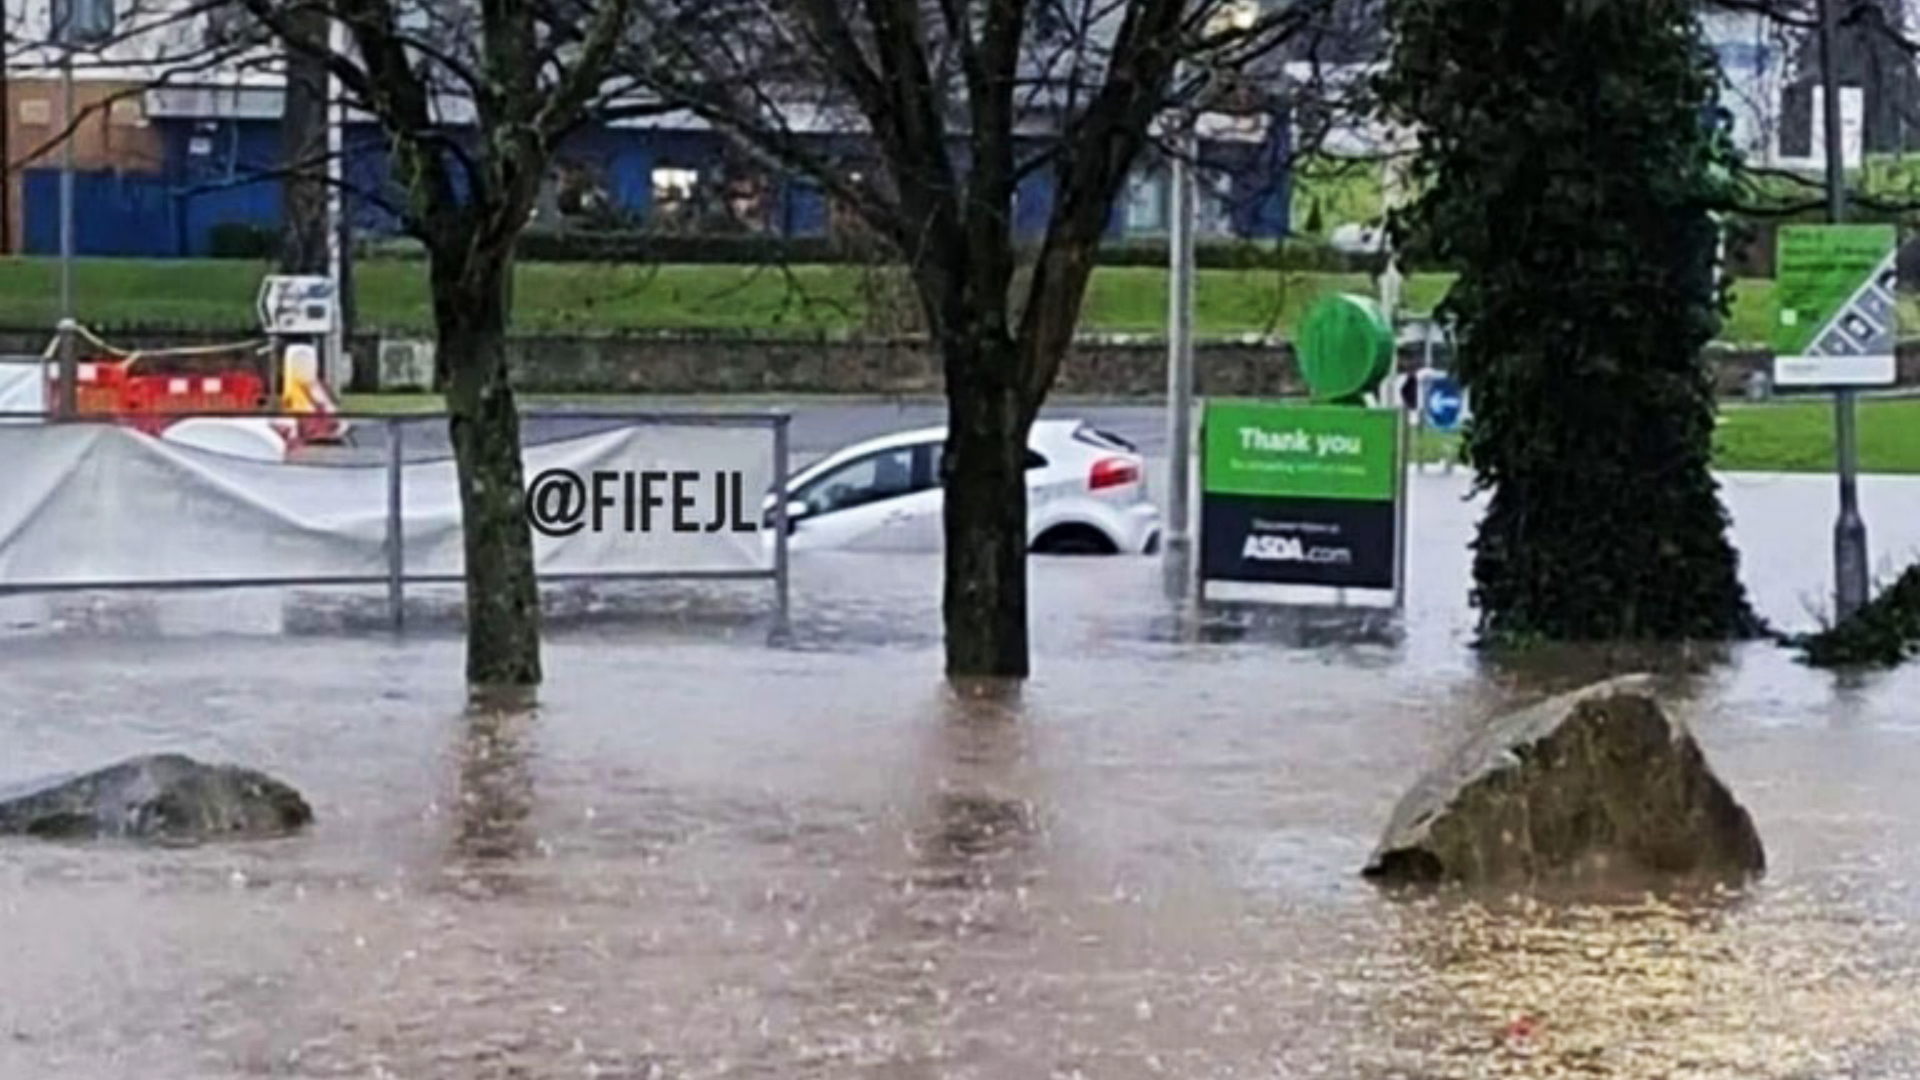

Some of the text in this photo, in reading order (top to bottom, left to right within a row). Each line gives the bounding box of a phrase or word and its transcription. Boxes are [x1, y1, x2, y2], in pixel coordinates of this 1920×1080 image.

[1239, 427, 1361, 456] Thank you
[1242, 534, 1352, 564] ASDA.com
